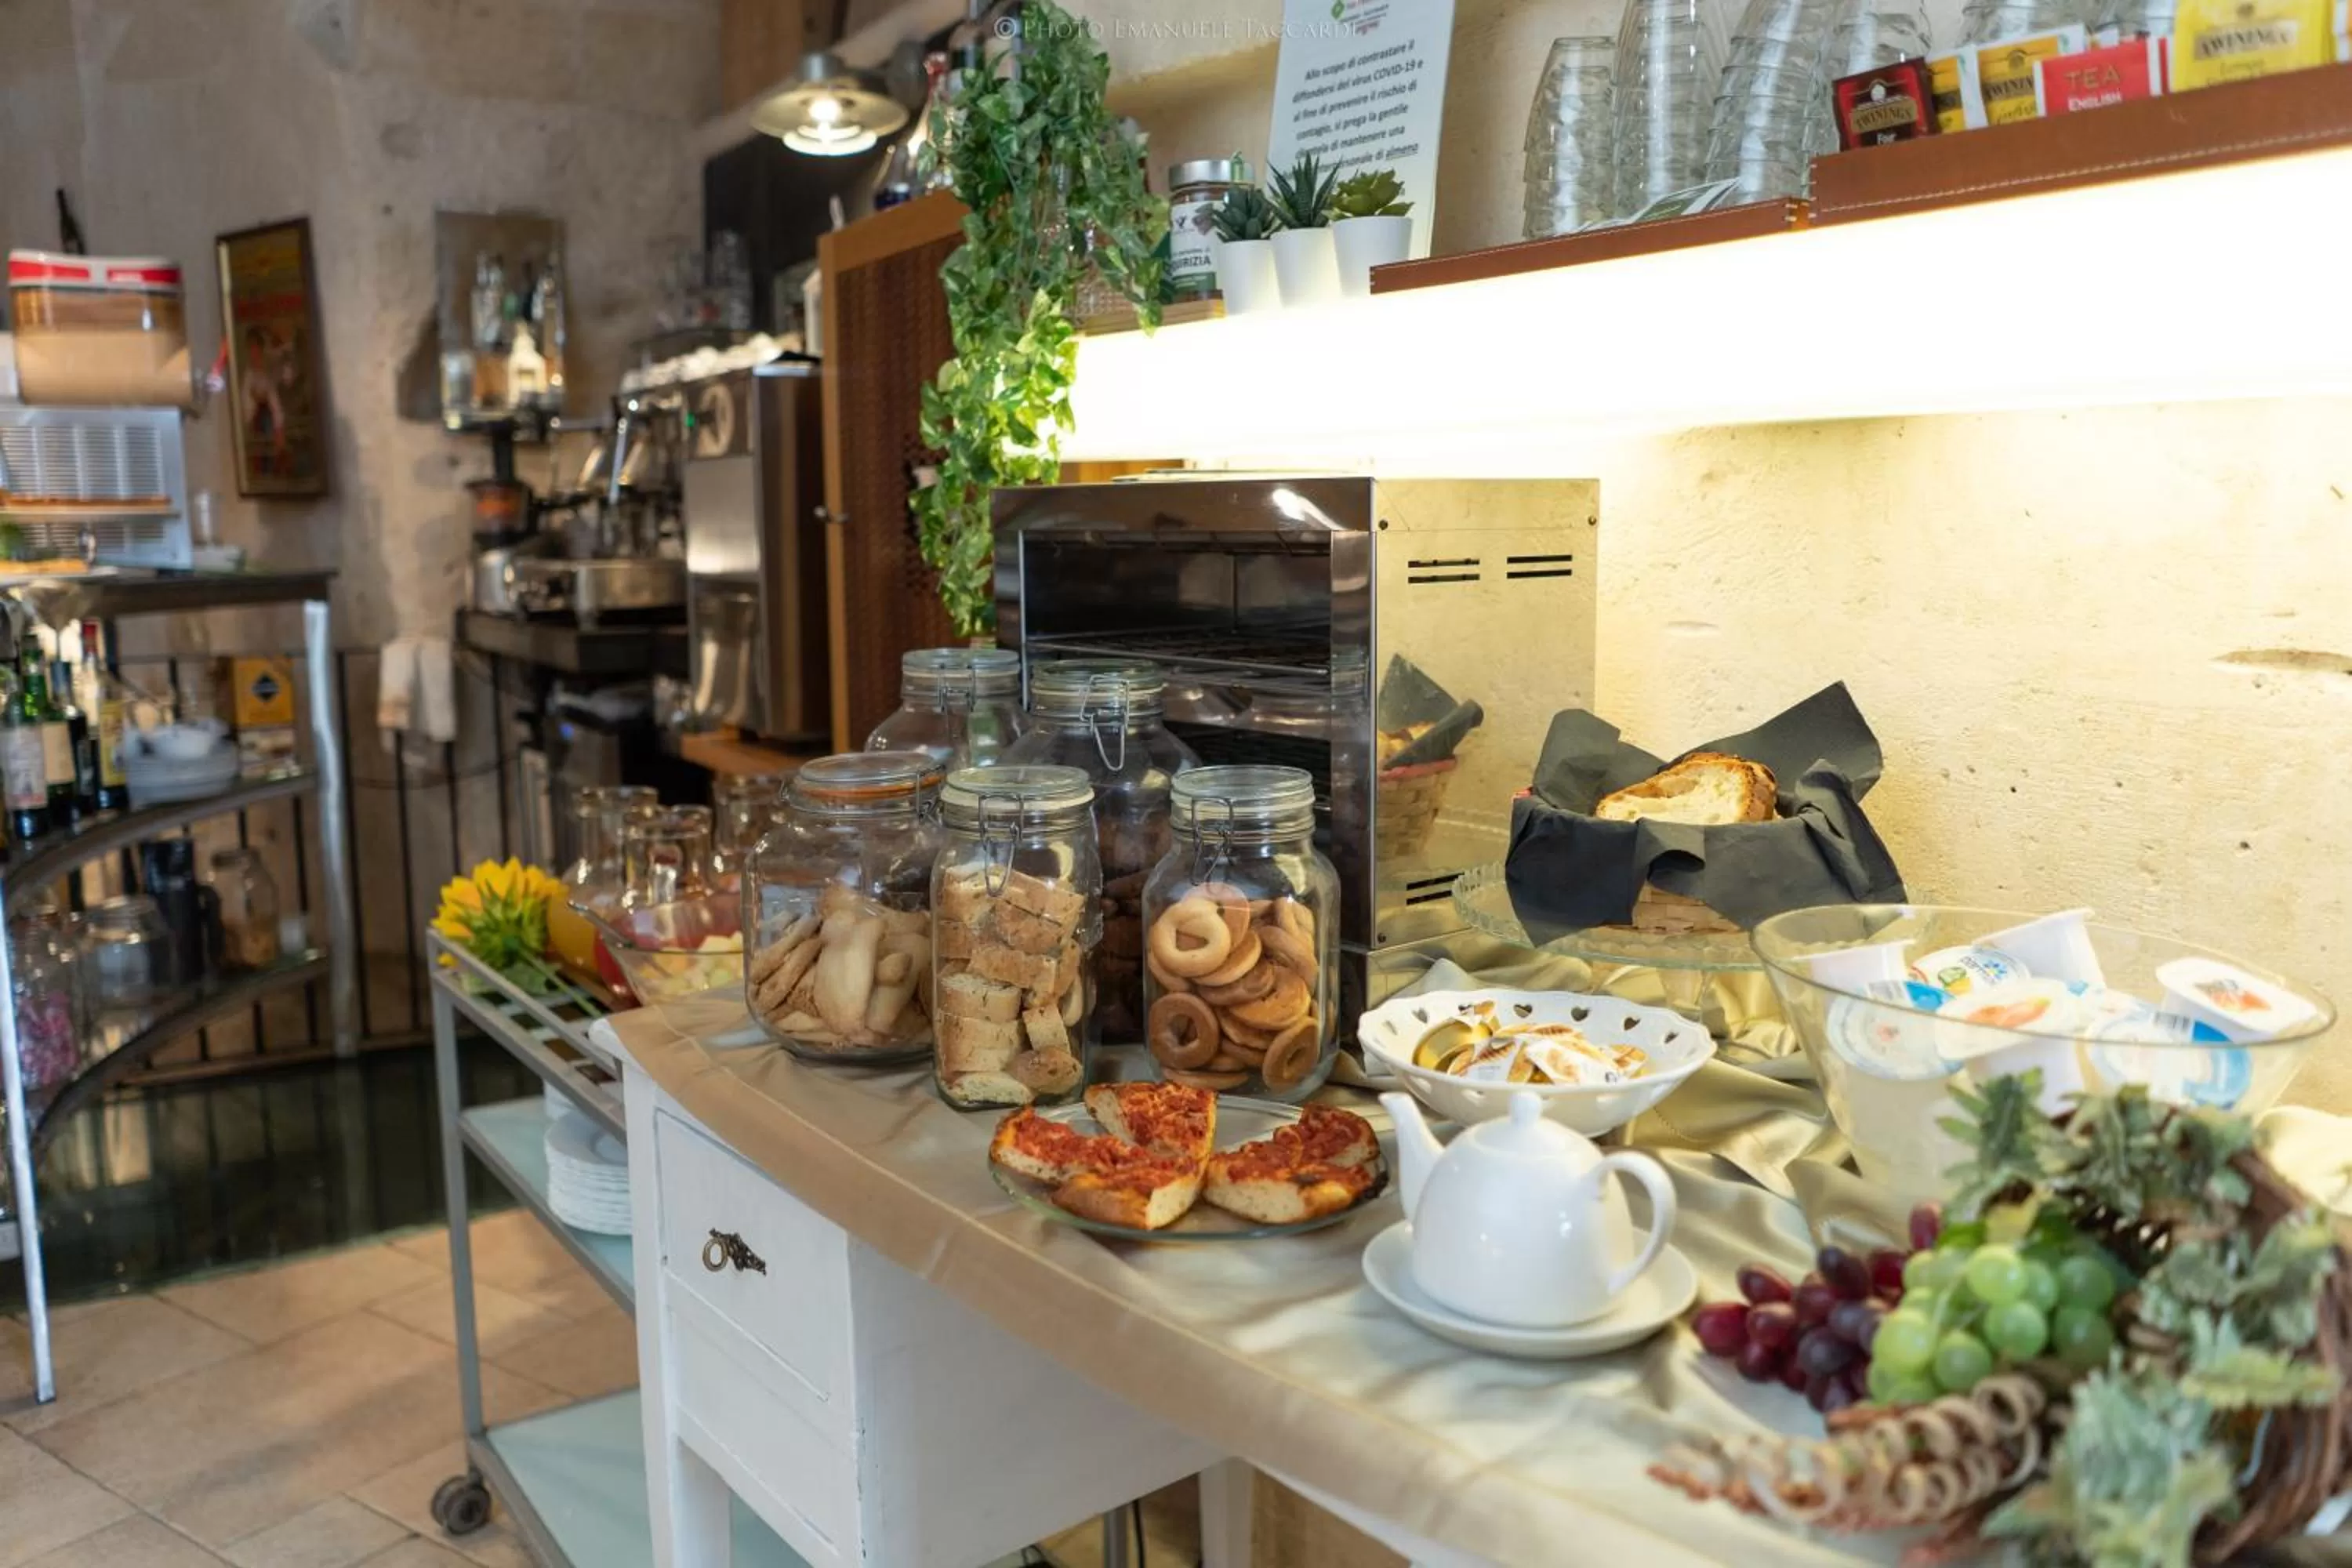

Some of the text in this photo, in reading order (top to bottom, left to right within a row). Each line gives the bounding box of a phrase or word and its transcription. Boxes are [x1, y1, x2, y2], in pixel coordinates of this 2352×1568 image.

[1322, 62, 1346, 75] scopo
[1348, 56, 1356, 69] di
[1357, 43, 1406, 66] contrastare
[1407, 38, 1415, 50] il
[1336, 79, 1350, 91] del
[1352, 74, 1371, 86] virus
[1373, 59, 1416, 81] COVID-19
[1417, 59, 1424, 69] e
[2064, 64, 2122, 89] TEA
[1319, 103, 1327, 115] di
[1328, 95, 1368, 114] prevenire
[1370, 89, 1377, 101] il
[1377, 84, 1406, 100] rischio
[1408, 78, 1417, 92] di
[2068, 90, 2122, 111] ENGLISH
[1342, 115, 1367, 131] prega
[1368, 111, 1377, 122] la
[1378, 103, 1409, 122] gentile
[1855, 106, 1912, 130] TWININGS
[1330, 139, 1339, 151] di
[1340, 130, 1387, 148] mantenere
[1388, 125, 1406, 137] una
[1385, 143, 1419, 160] almeno
